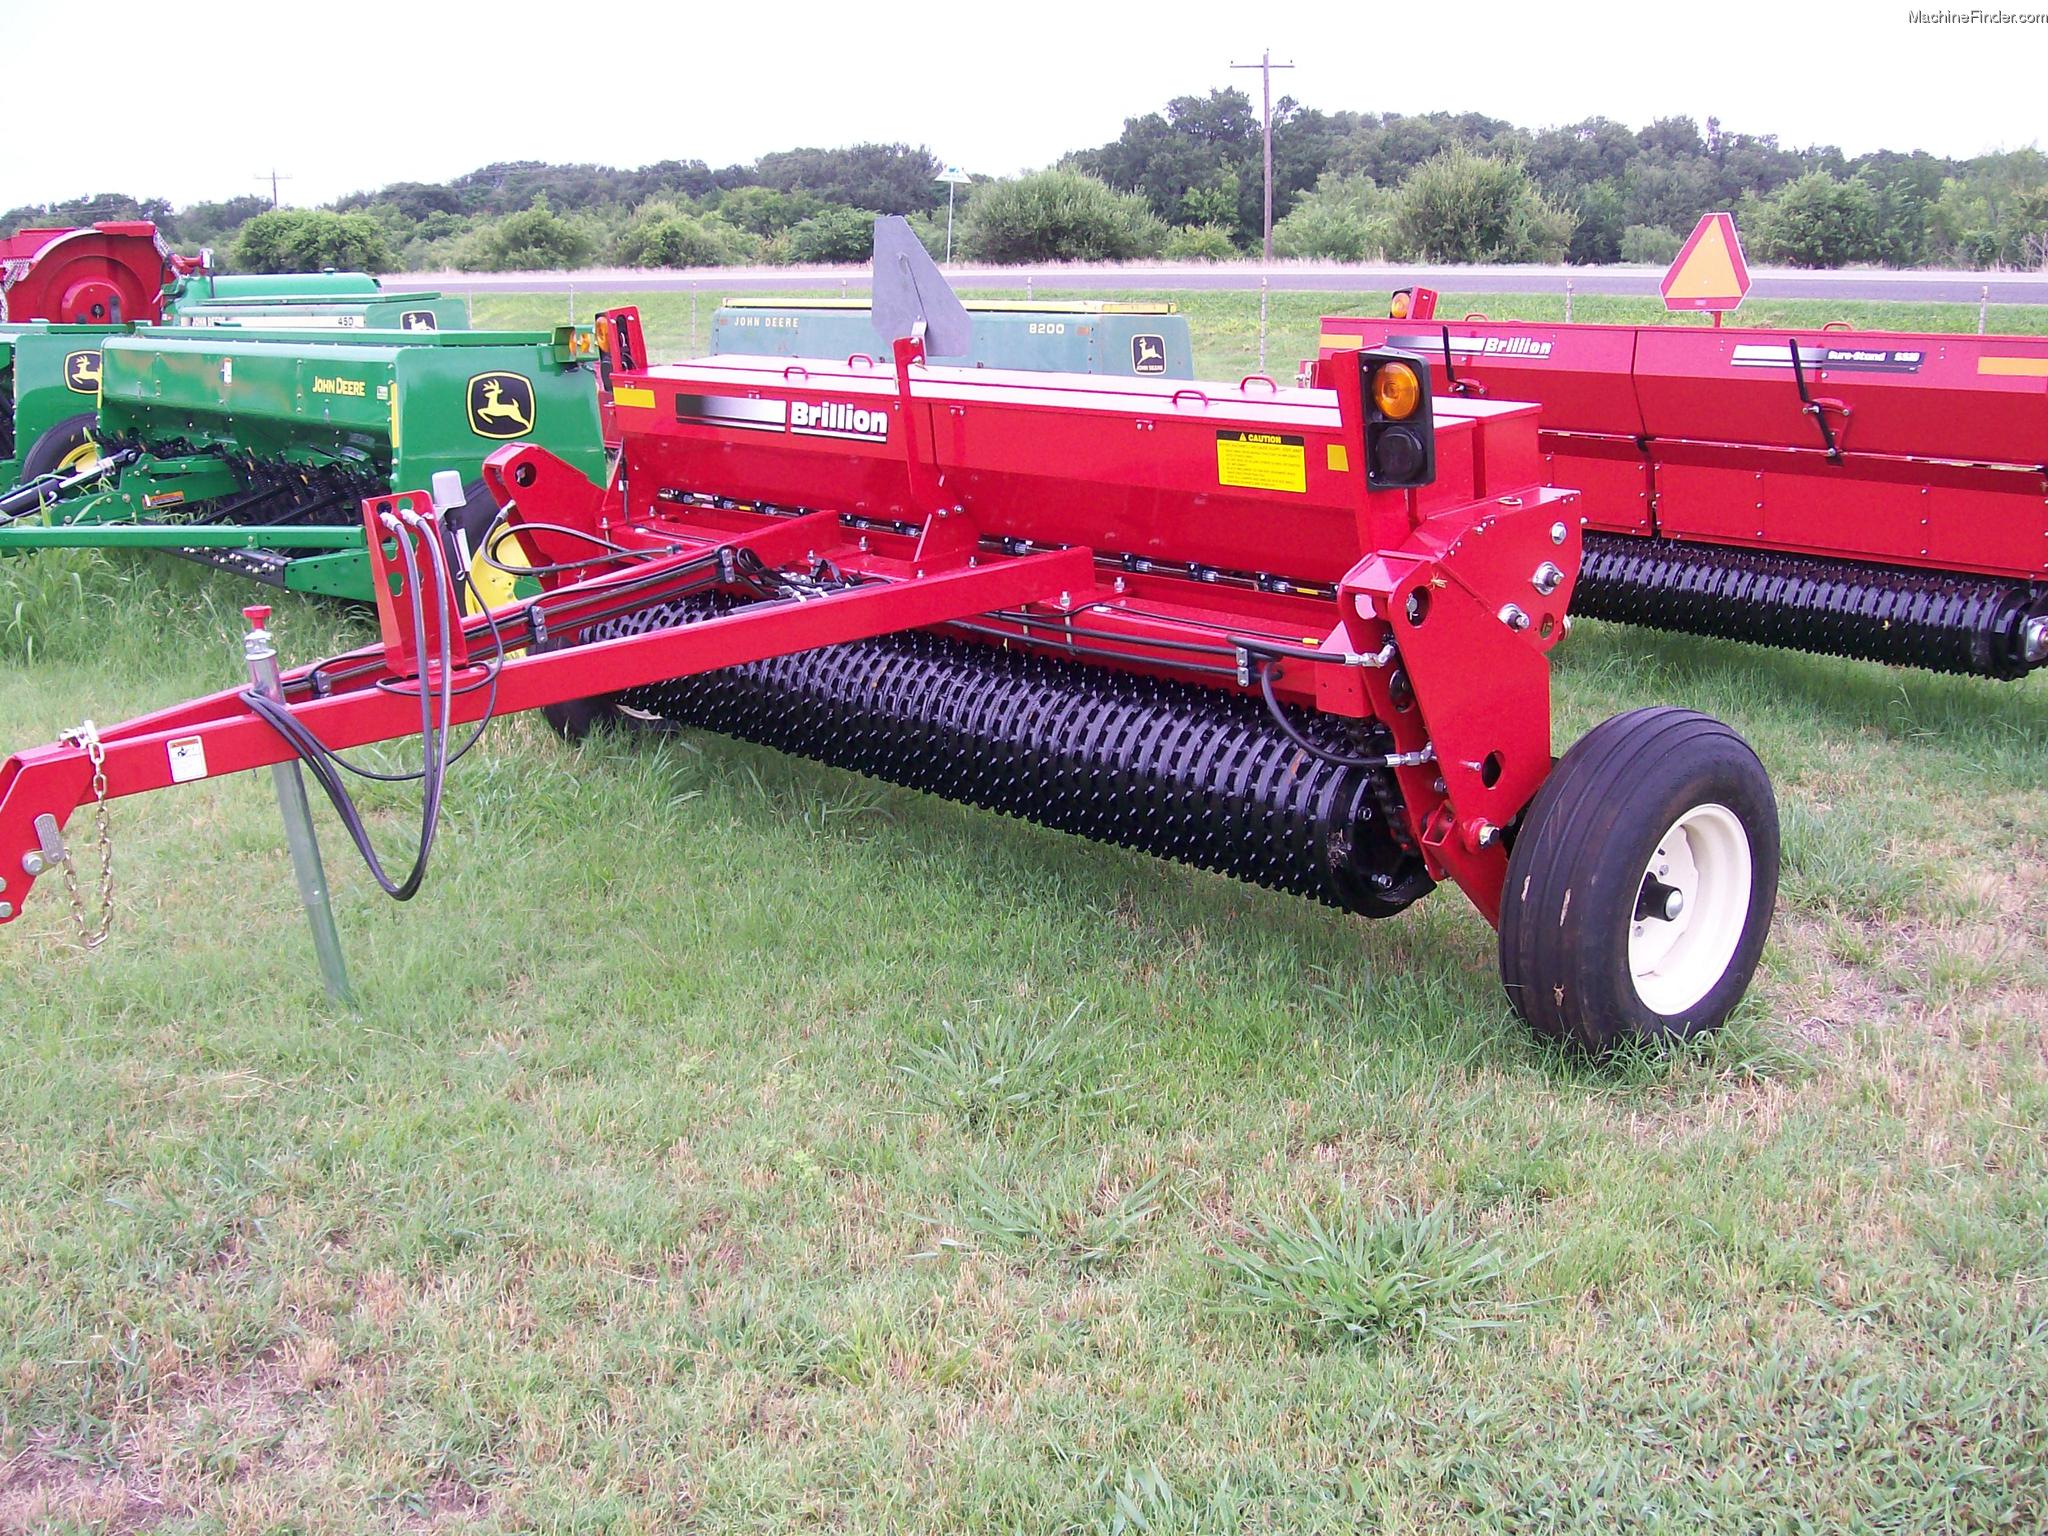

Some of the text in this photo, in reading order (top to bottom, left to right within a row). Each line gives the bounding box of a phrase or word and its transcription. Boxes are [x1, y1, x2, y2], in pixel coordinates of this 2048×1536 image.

[734, 316, 799, 328] JOHN DEERE
[1029, 323, 1065, 335] 8200
[1484, 337, 1552, 355] Brillion
[312, 375, 336, 394] JOHN
[336, 377, 366, 397] DEERE
[790, 400, 888, 434] Brillion
[1247, 434, 1282, 444] CAUTION
